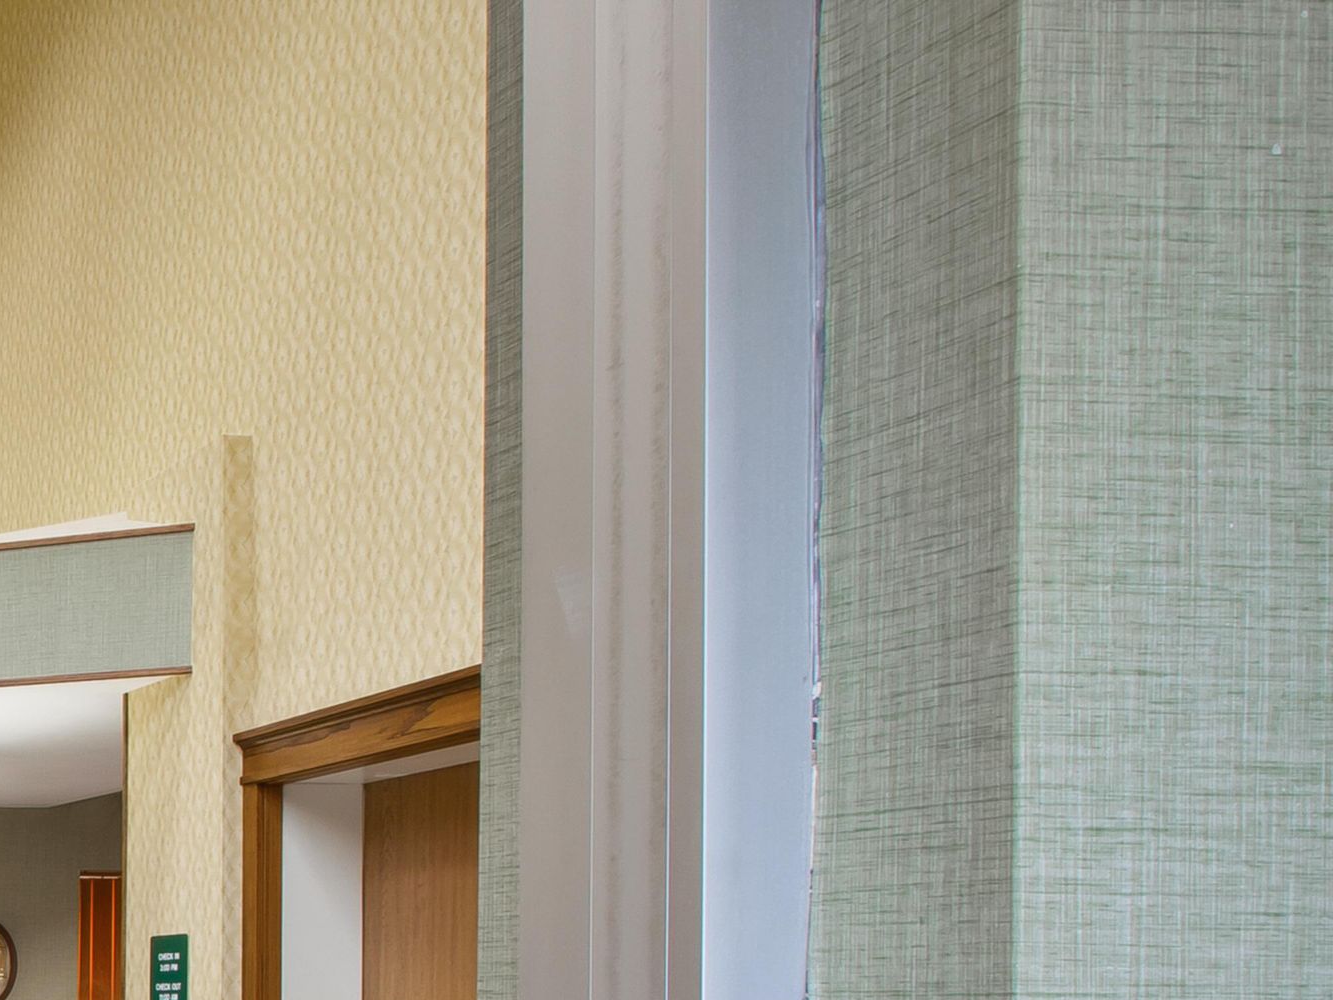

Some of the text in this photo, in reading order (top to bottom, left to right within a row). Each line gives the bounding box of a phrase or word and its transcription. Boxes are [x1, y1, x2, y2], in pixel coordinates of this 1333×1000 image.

[158, 952, 180, 961] CHECK IN
[170, 963, 178, 971] PM
[155, 982, 181, 991] CHECK OUT
